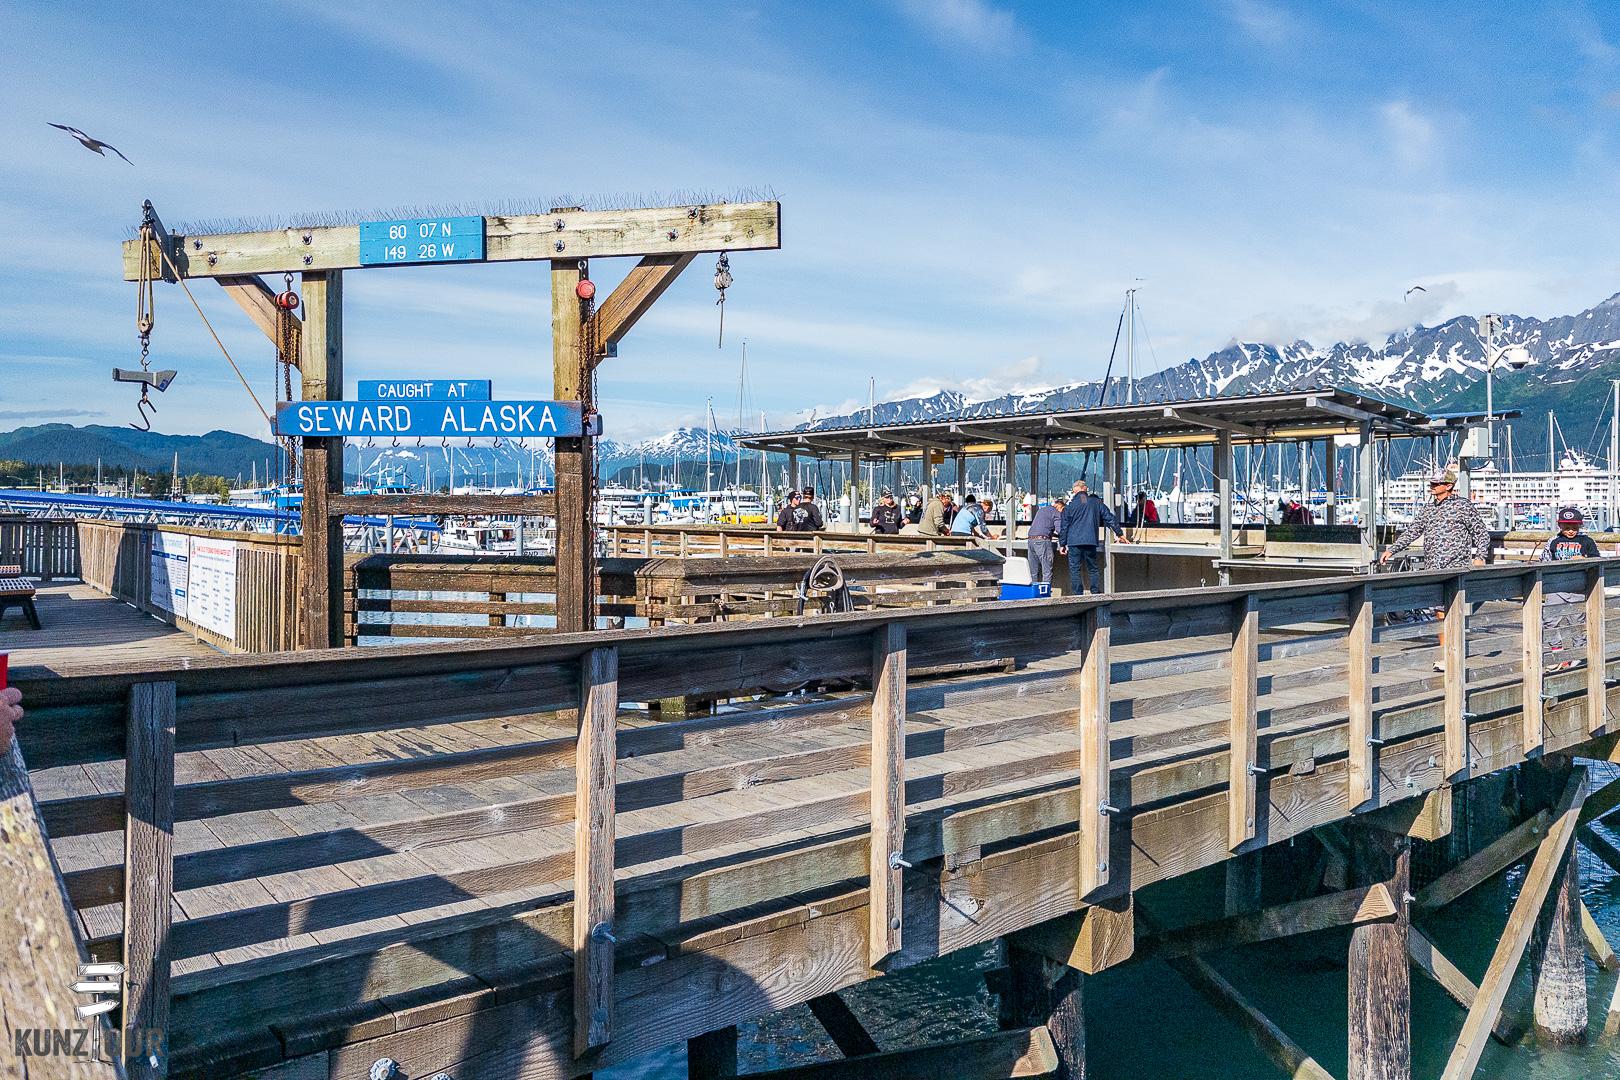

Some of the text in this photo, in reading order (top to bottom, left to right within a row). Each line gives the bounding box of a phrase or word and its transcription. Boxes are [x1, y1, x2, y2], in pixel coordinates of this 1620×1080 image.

[389, 221, 451, 240] 60 07 N
[384, 243, 455, 260] 149 26 W
[377, 382, 468, 398] CAUGHT AT
[298, 404, 558, 433] SEWARD ALASKA
